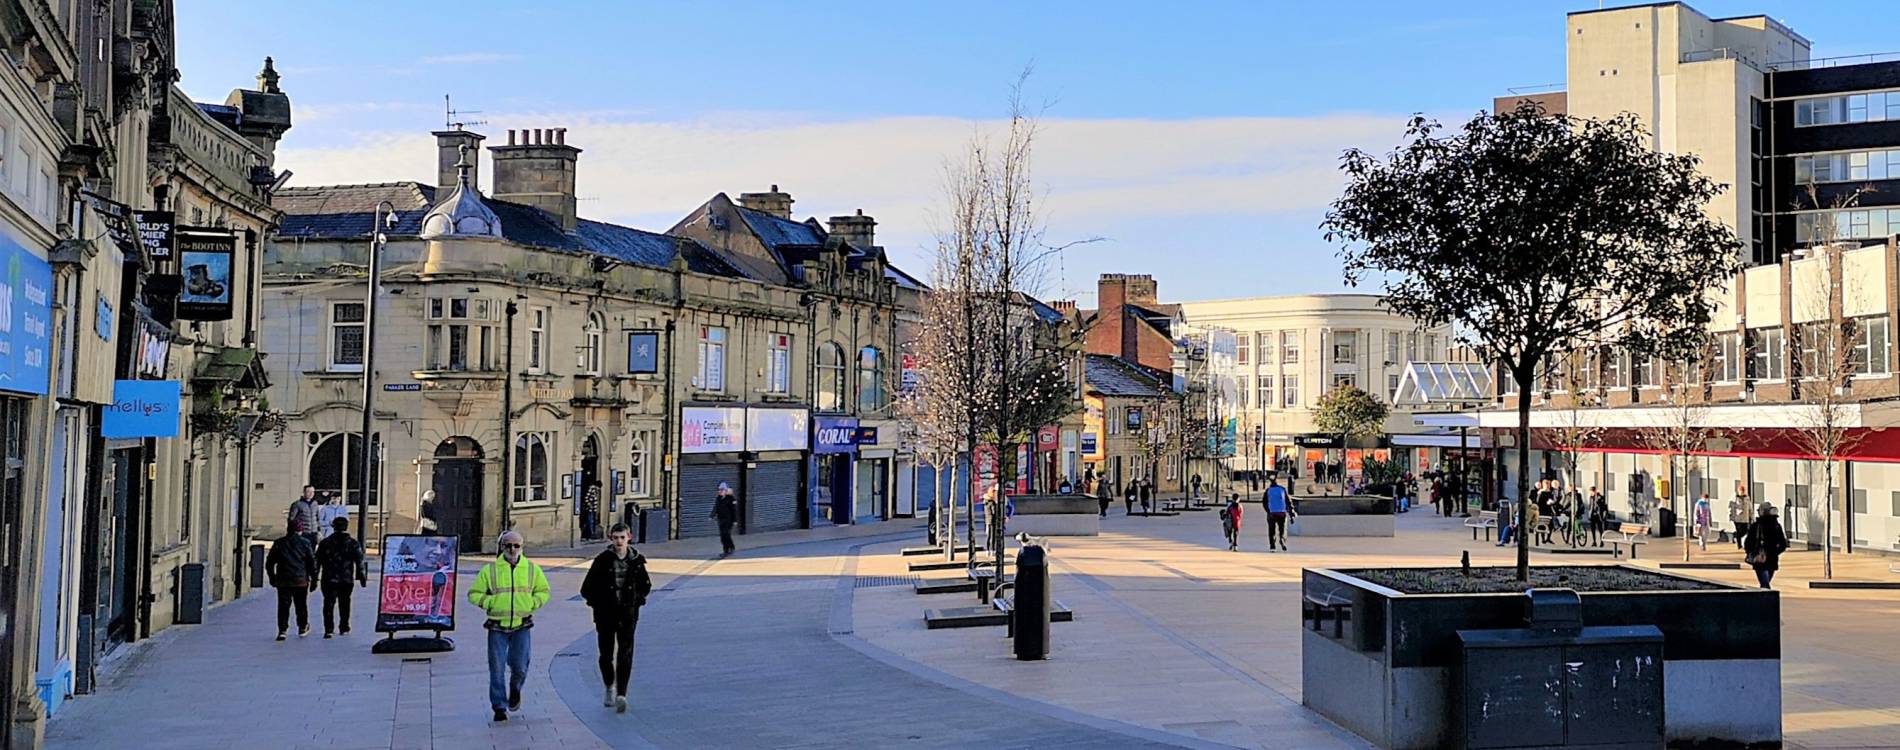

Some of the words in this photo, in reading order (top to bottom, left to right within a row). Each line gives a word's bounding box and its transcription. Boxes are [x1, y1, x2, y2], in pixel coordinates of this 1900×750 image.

[192, 243, 215, 251] BOOT
[818, 428, 850, 444] CORAL
[386, 582, 426, 605] byte
